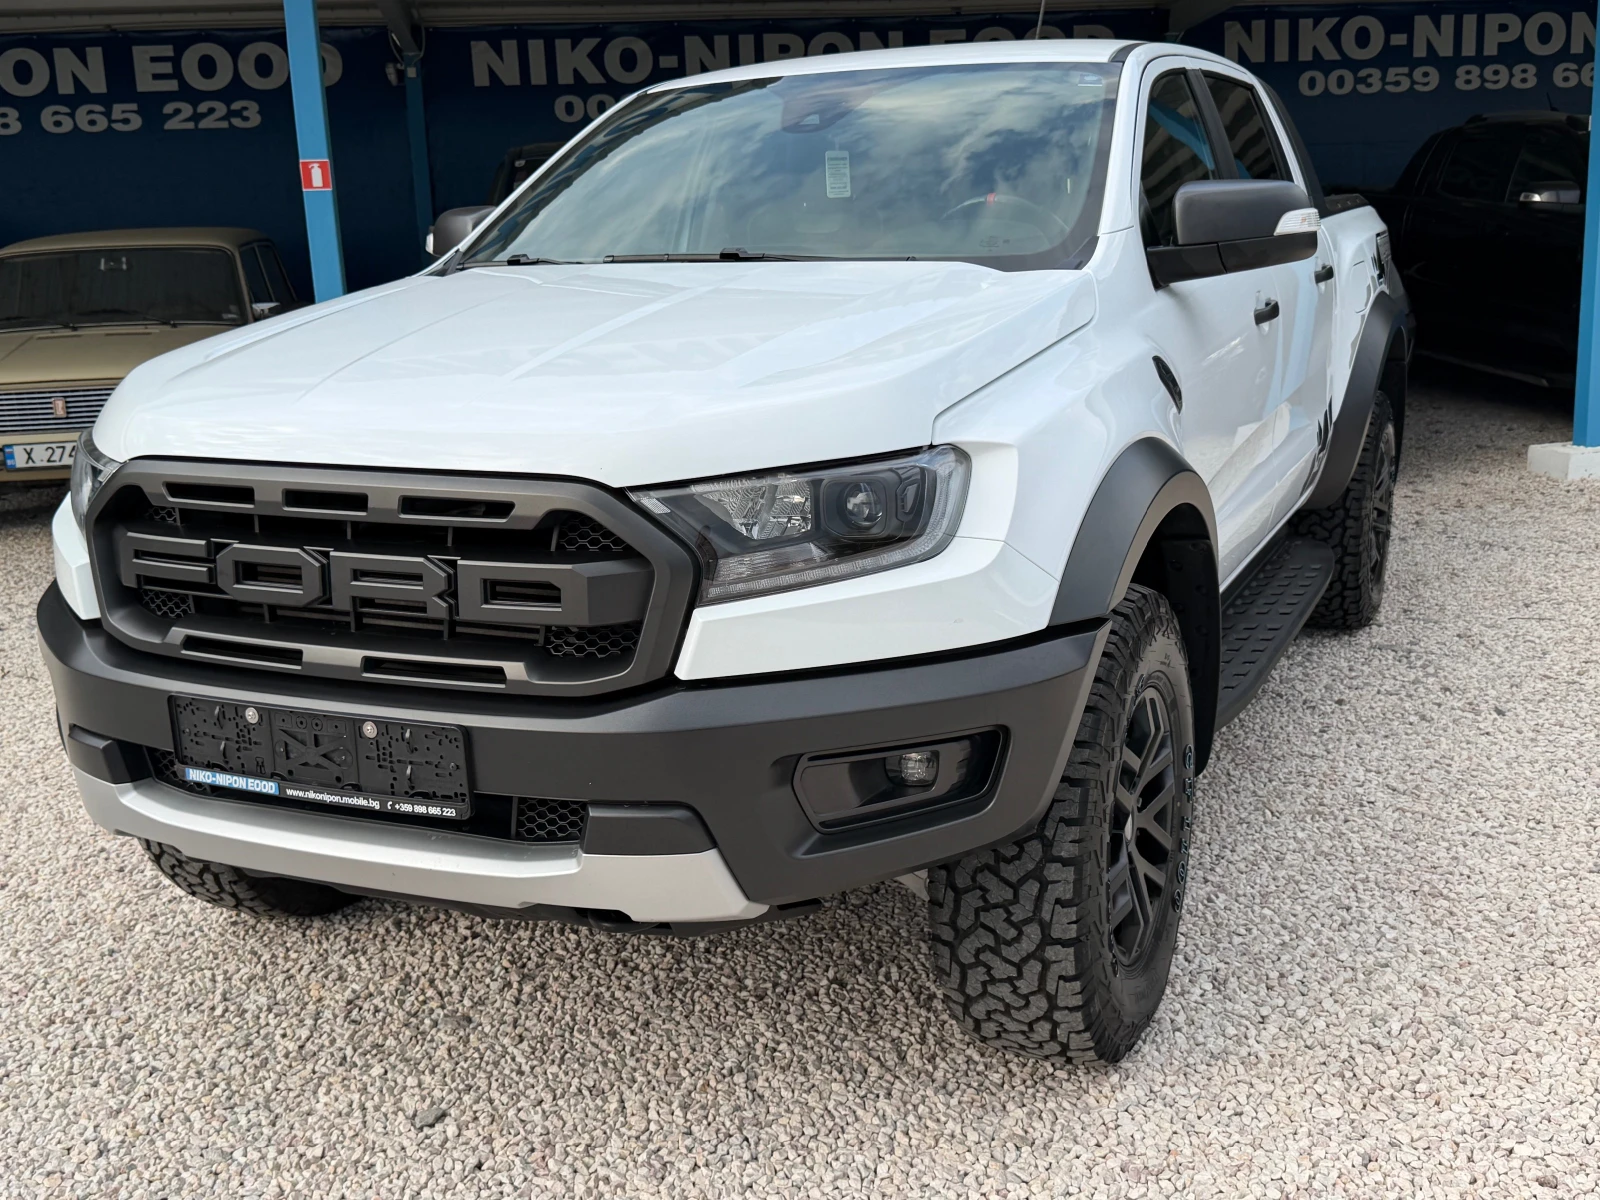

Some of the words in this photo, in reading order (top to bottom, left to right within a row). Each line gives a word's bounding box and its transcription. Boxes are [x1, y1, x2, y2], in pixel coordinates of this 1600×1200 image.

[0, 46, 107, 97] ON
[1298, 66, 1439, 97] 00359
[1454, 63, 1538, 91] 898
[40, 103, 142, 134] 665
[163, 100, 262, 130] 223
[554, 93, 632, 123] 00
[23, 447, 36, 465] X
[120, 531, 590, 627] FORD
[189, 768, 247, 790] NIKO-NIPON
[247, 778, 276, 794] EOOD
[286, 788, 380, 810] www.nikonipon.mobile.bg
[395, 804, 413, 813] +359
[413, 805, 428, 814] 898
[428, 806, 442, 816] 665
[442, 807, 457, 817] 223
